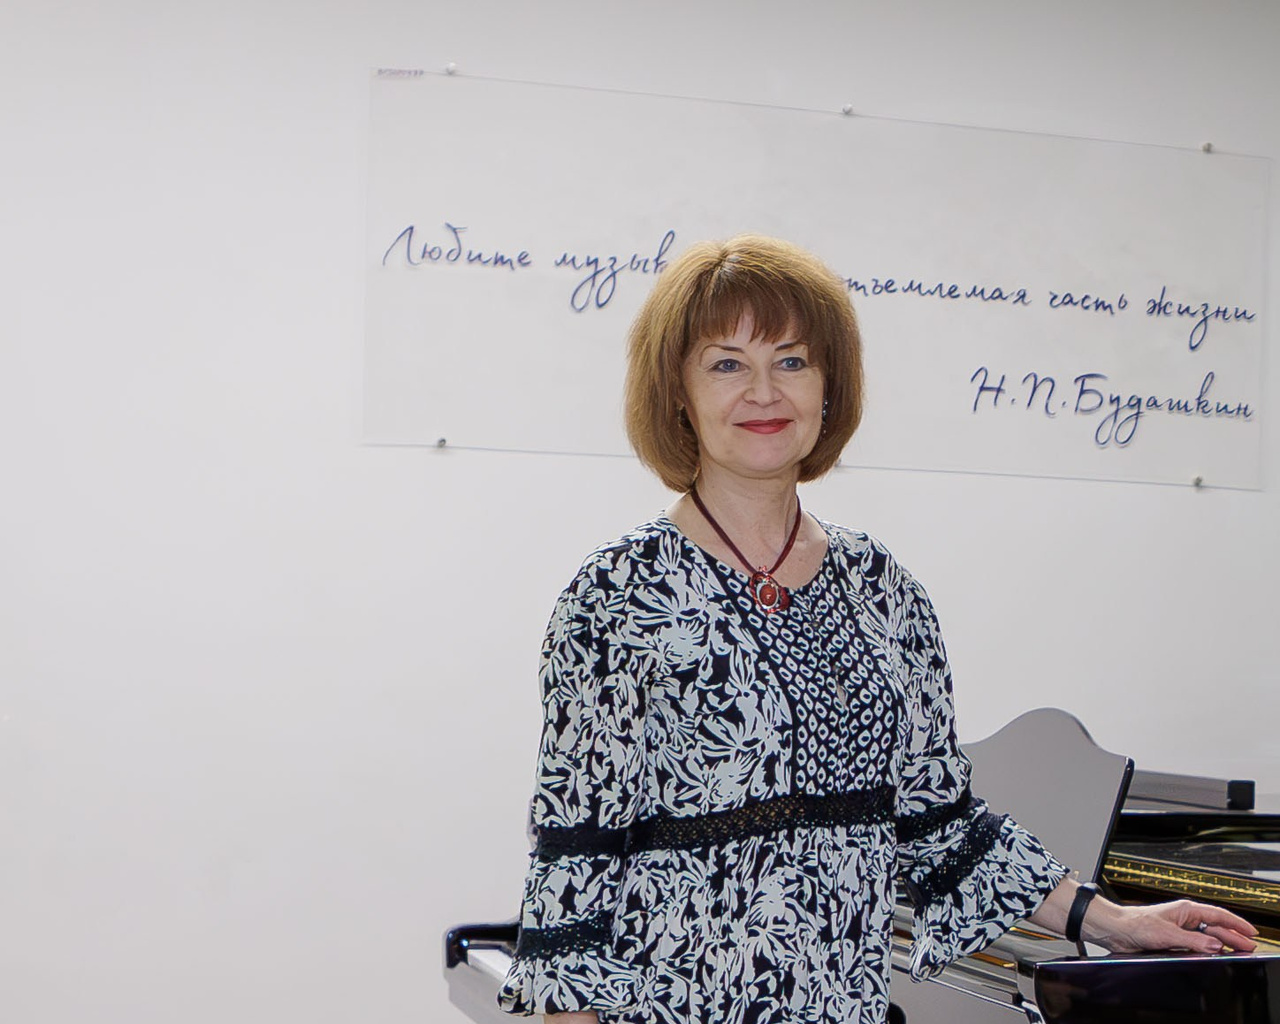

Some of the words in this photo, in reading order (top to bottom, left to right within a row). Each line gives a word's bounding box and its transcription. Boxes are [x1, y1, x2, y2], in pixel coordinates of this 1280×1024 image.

[383, 223, 532, 272] Любите
[554, 230, 676, 313] музык
[845, 277, 1033, 306] тъемлемая
[1049, 290, 1129, 316] часть
[1146, 286, 1257, 352] жизни
